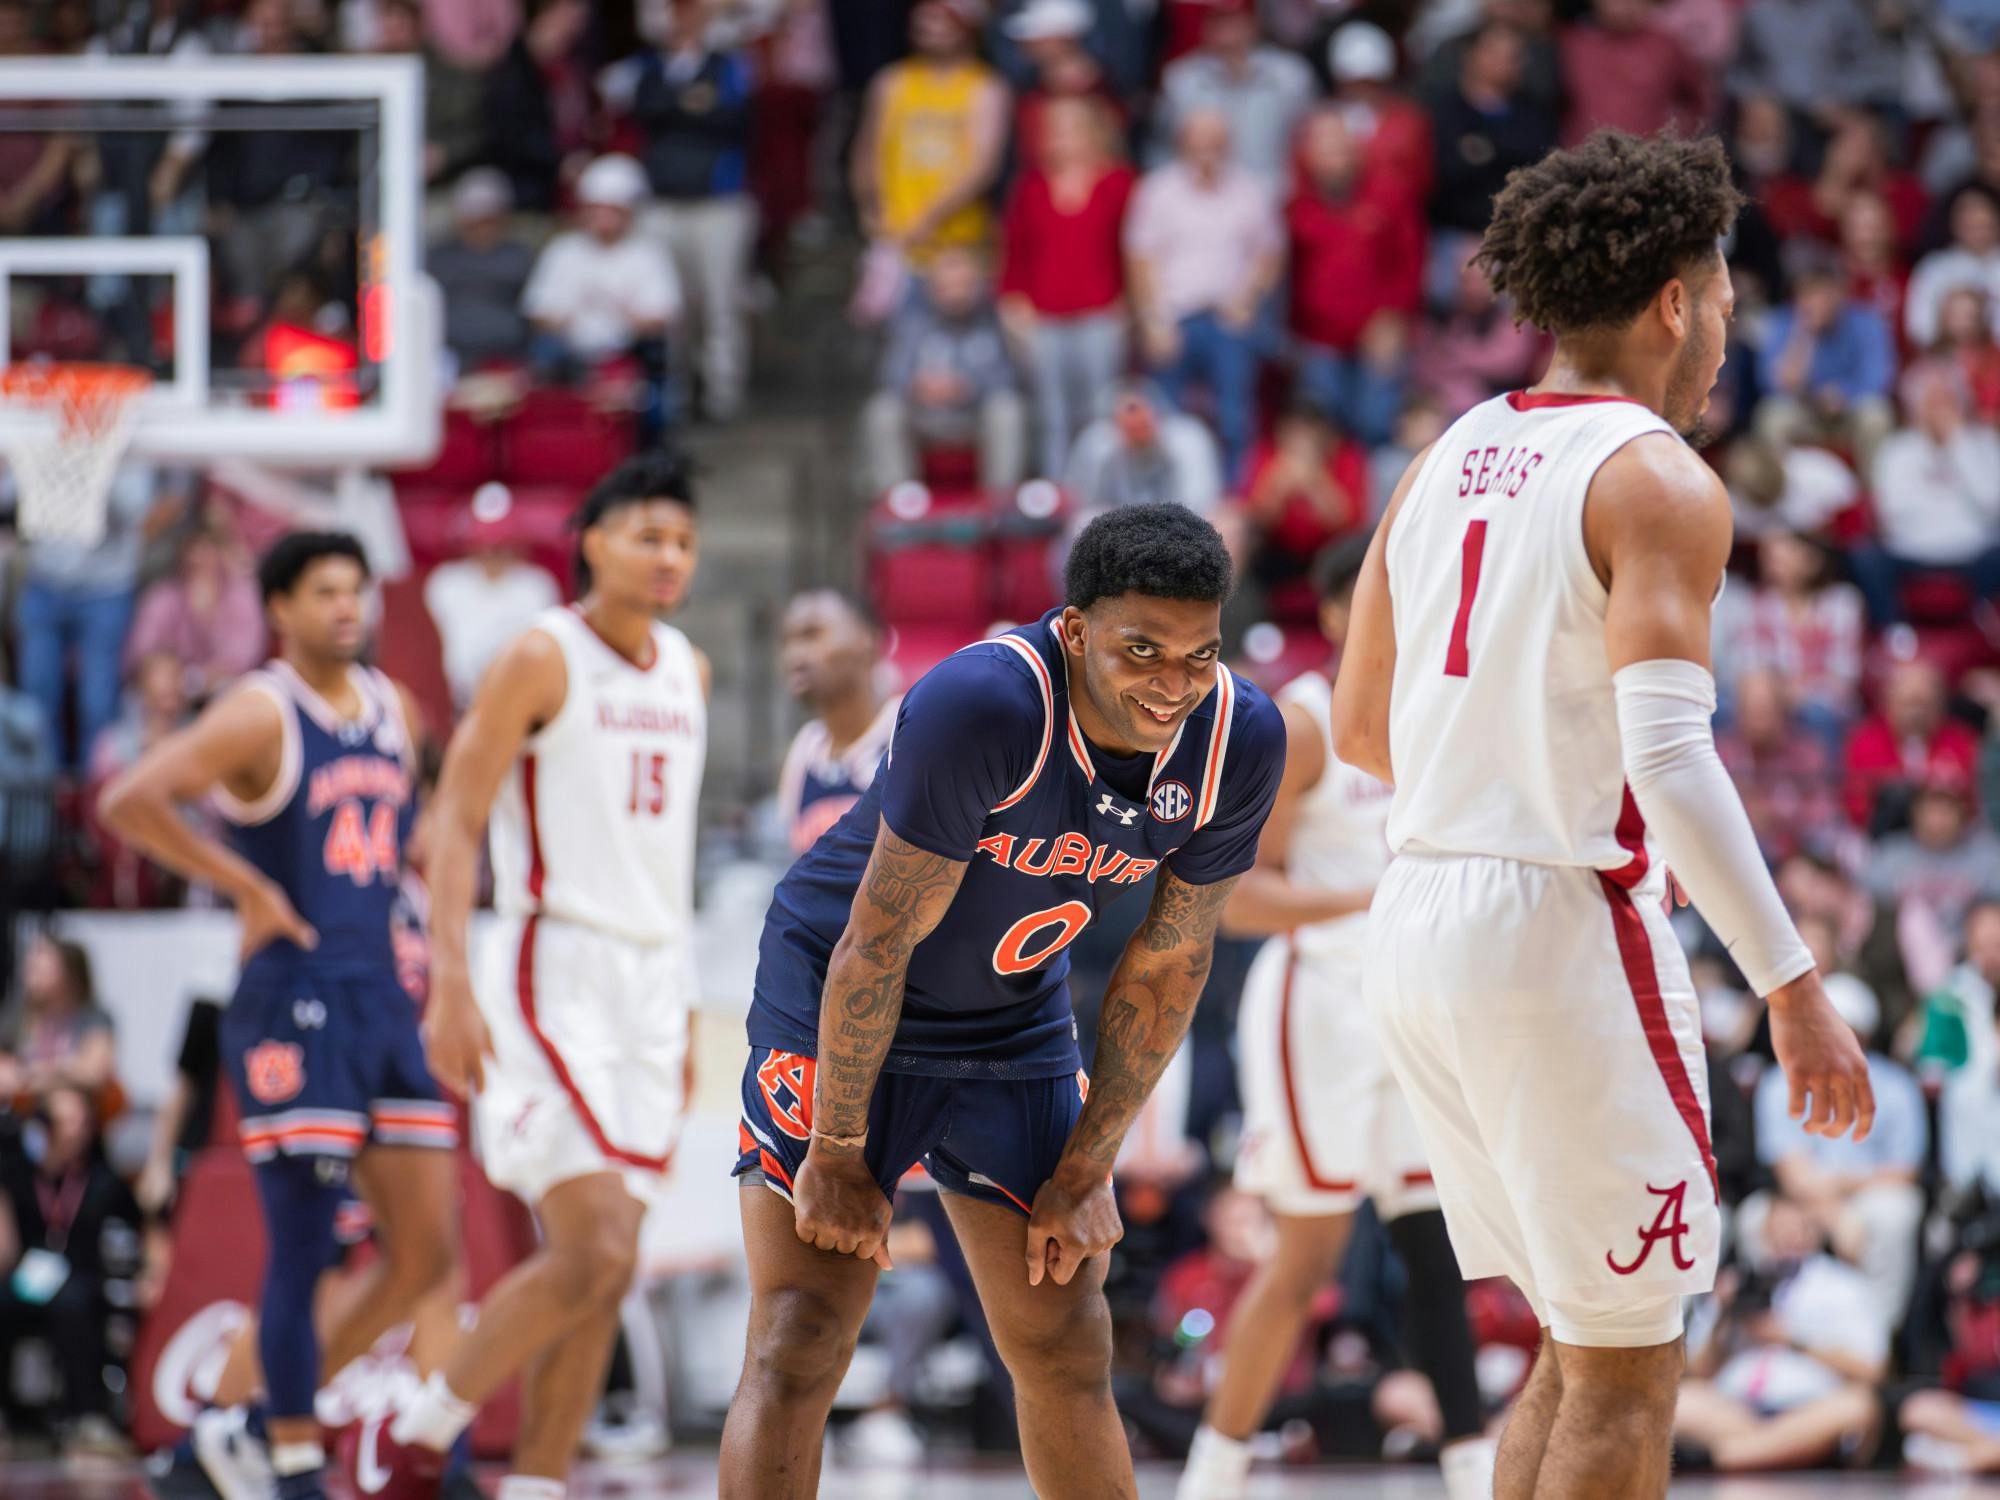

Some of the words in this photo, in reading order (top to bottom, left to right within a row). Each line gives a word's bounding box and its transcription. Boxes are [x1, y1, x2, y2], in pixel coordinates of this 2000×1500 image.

[1443, 519, 1488, 678] 1
[627, 751, 668, 816] 15
[1153, 783, 1189, 820] SEC
[323, 799, 400, 886] 44
[974, 831, 1162, 885] AUBUR
[992, 899, 1093, 976] 0
[1606, 1180, 1695, 1275] A
